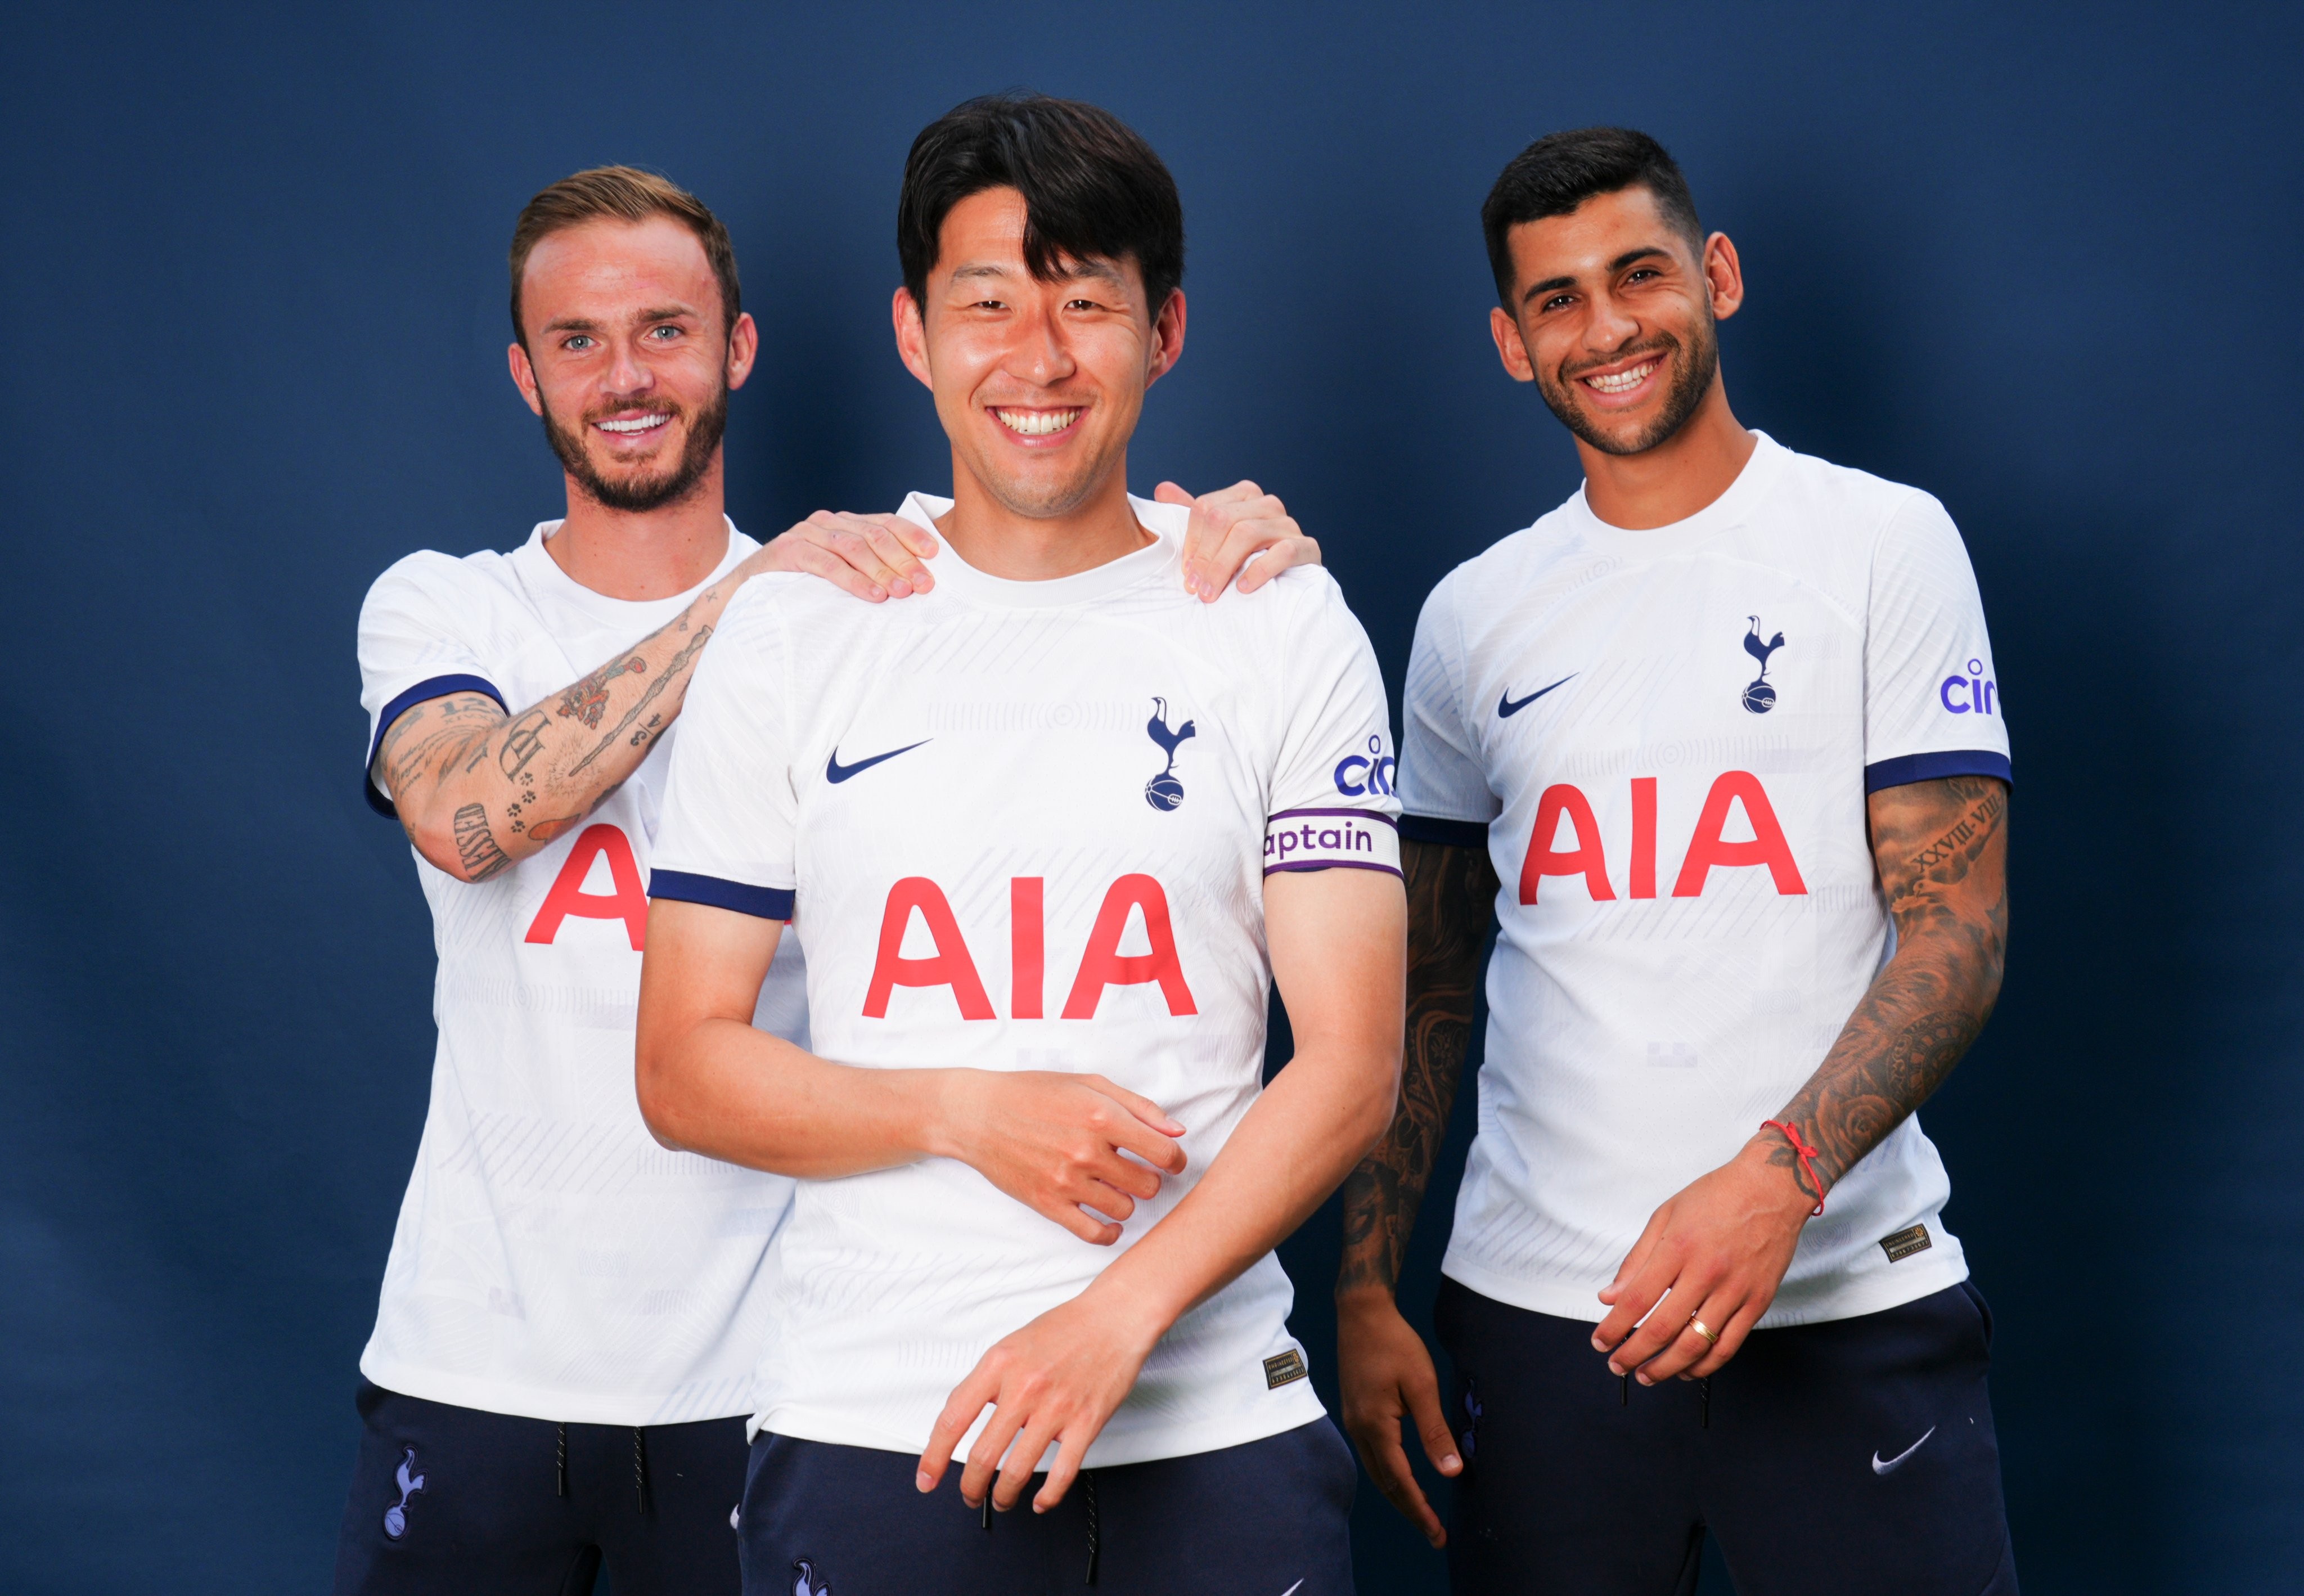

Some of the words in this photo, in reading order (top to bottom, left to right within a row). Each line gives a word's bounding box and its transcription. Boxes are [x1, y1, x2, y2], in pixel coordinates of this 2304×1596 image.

[1263, 821, 1372, 860] aptain
[1520, 771, 1807, 905] AIA
[862, 873, 1198, 1020] AIA
